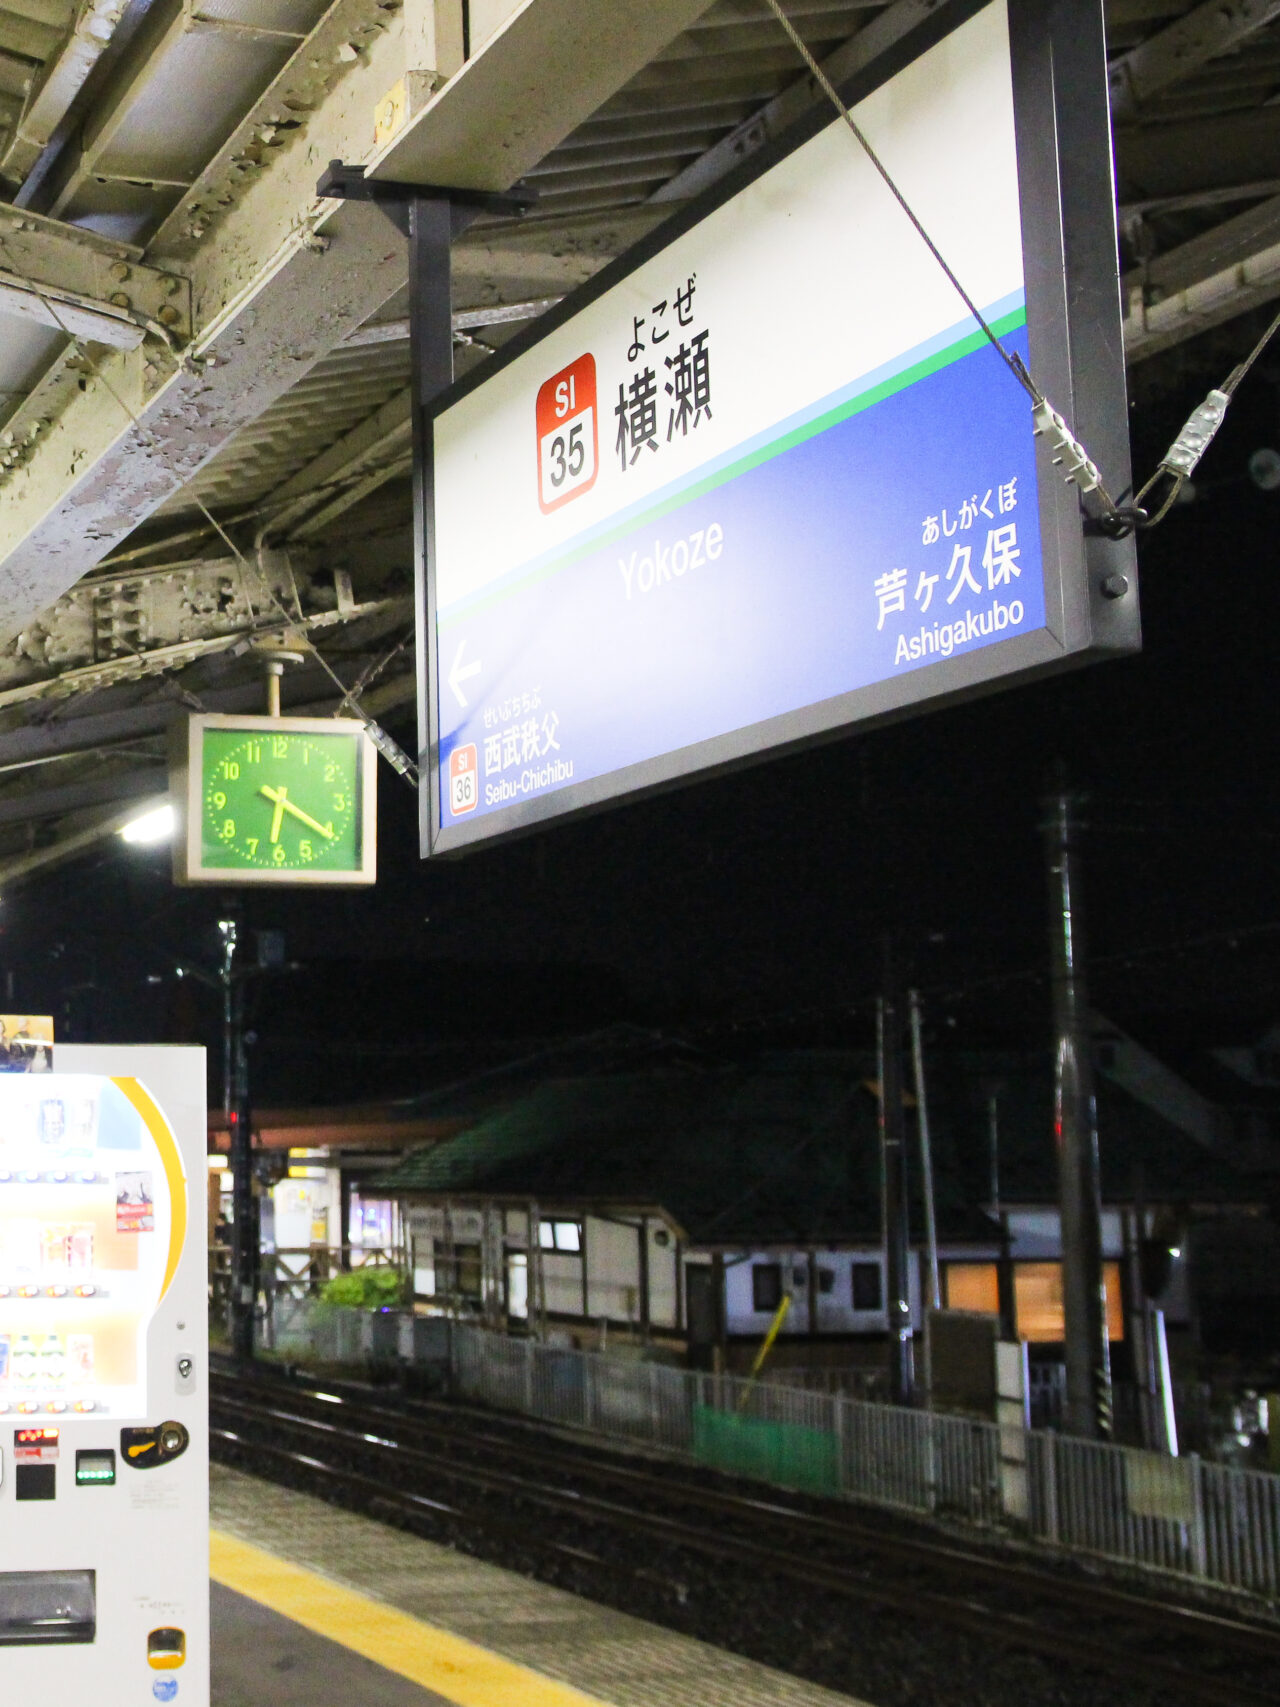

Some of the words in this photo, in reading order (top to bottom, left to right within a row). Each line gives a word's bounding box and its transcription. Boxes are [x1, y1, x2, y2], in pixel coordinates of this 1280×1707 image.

[627, 272, 697, 362] よこぜ
[554, 374, 576, 418] SI
[614, 328, 713, 472] 横瀬
[550, 422, 585, 488] 35
[921, 476, 1018, 546] あしがくぼ
[617, 521, 724, 601] Yokoze
[894, 599, 1024, 666] Ashigakubo
[483, 687, 542, 729] せいぶちちぶ
[247, 741, 261, 764] 11
[272, 741, 288, 759] 12
[483, 710, 561, 777] 西武秩父
[303, 749, 310, 765] 1
[457, 751, 469, 772] SI
[223, 762, 240, 780] 10
[324, 764, 336, 782] 2
[456, 776, 471, 803] 36
[484, 760, 574, 806] Seibu-Chichibu
[213, 792, 226, 809] 9
[333, 793, 346, 811] 3
[223, 819, 236, 838] 8
[246, 838, 259, 856] 7
[272, 844, 286, 862] 6
[299, 840, 313, 858] 5
